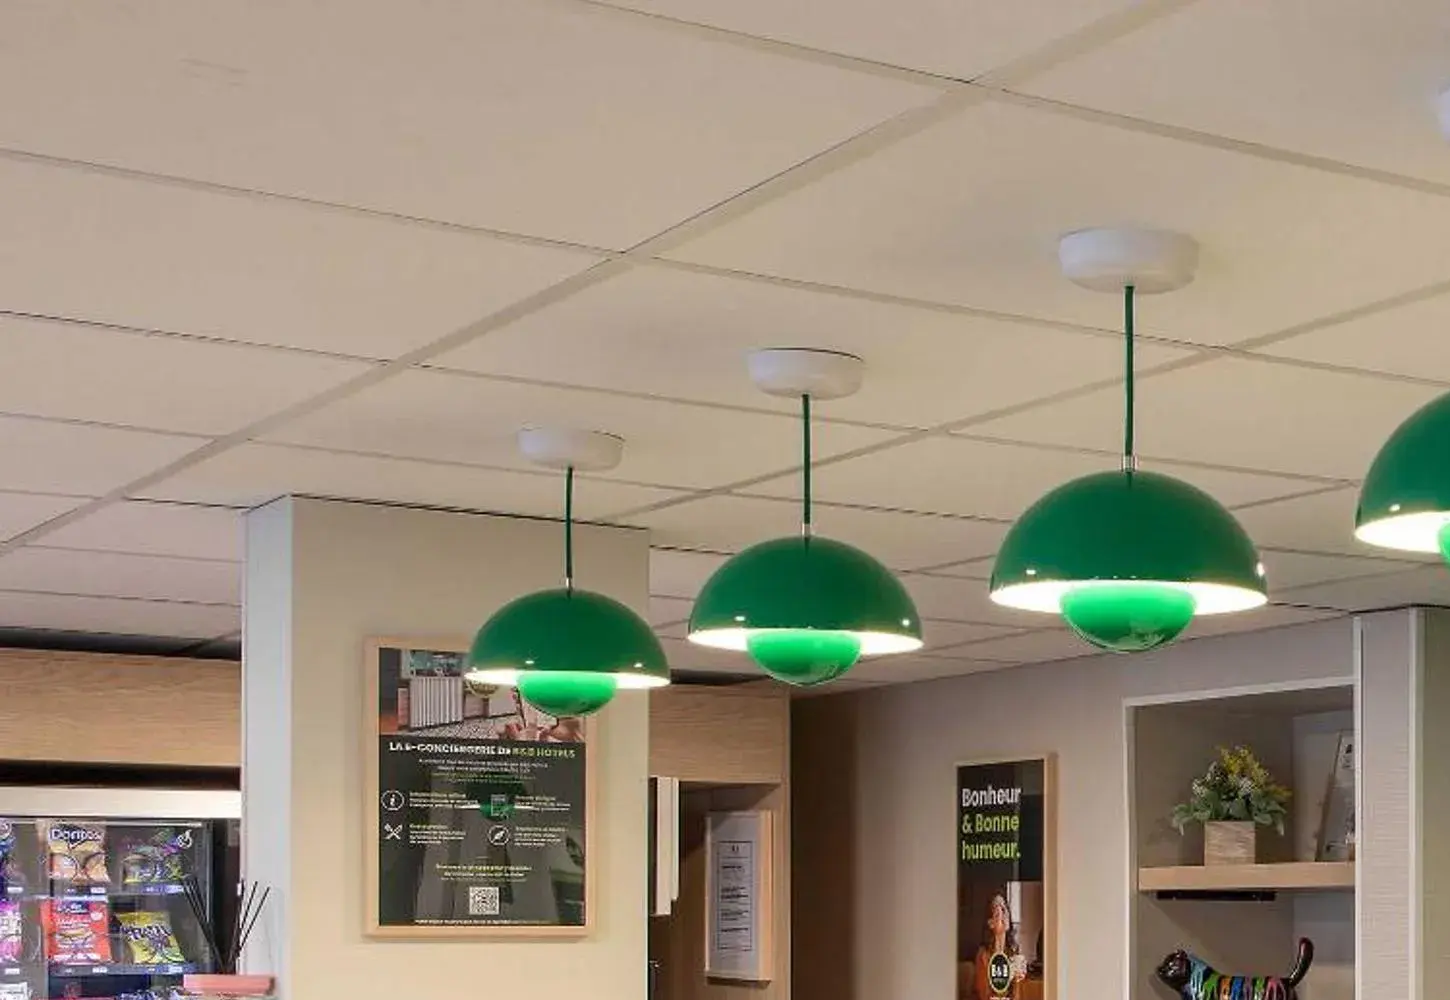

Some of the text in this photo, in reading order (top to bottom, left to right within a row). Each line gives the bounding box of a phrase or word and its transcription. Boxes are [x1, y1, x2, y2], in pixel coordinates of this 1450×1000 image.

[961, 785, 1022, 807] Bonheur
[962, 813, 1020, 834] & Bonne
[962, 840, 1021, 860] humeur.
